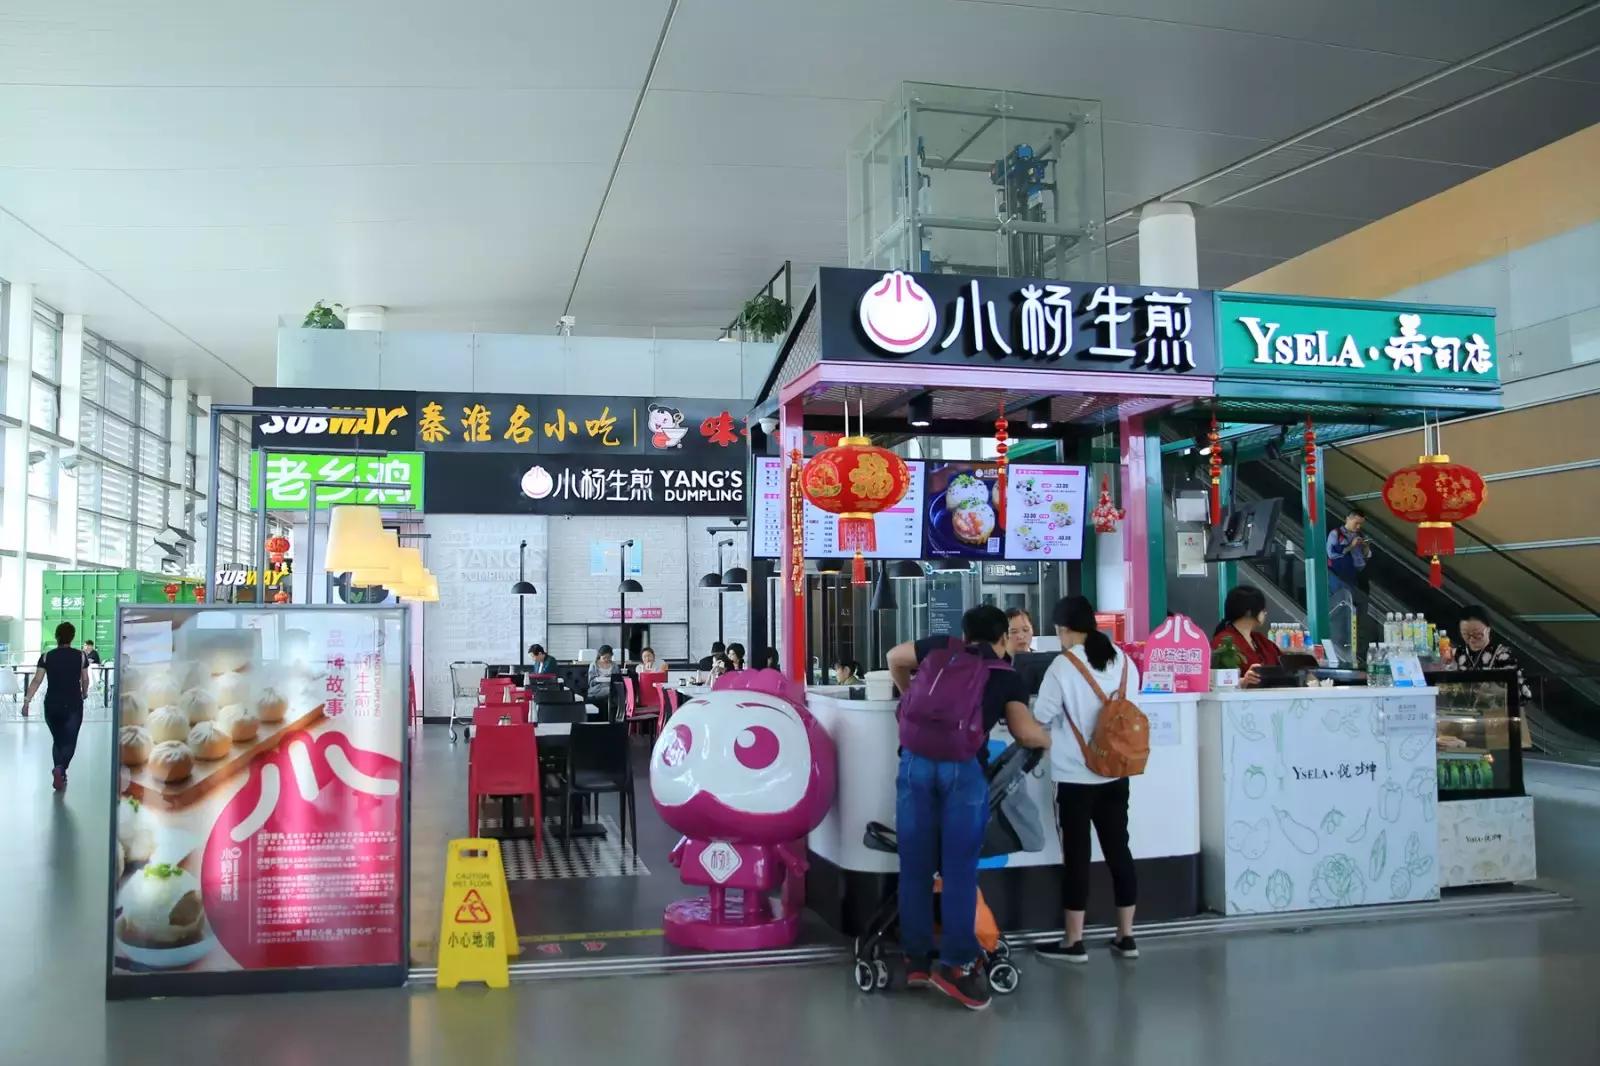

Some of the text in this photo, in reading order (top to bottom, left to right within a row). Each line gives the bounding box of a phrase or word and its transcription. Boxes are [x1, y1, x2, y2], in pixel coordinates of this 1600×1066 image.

[941, 279, 1197, 368] 小杨生煎
[259, 405, 408, 435] SUBWAY
[419, 401, 621, 446] 秦淮名小吃
[266, 457, 411, 502] 老乡鸡
[553, 467, 653, 501] 小杨生煎
[659, 469, 743, 488] YANG'S
[665, 489, 743, 501] DUMPLING
[215, 569, 289, 585] SUBWAY
[448, 931, 496, 949] 小心地滑
